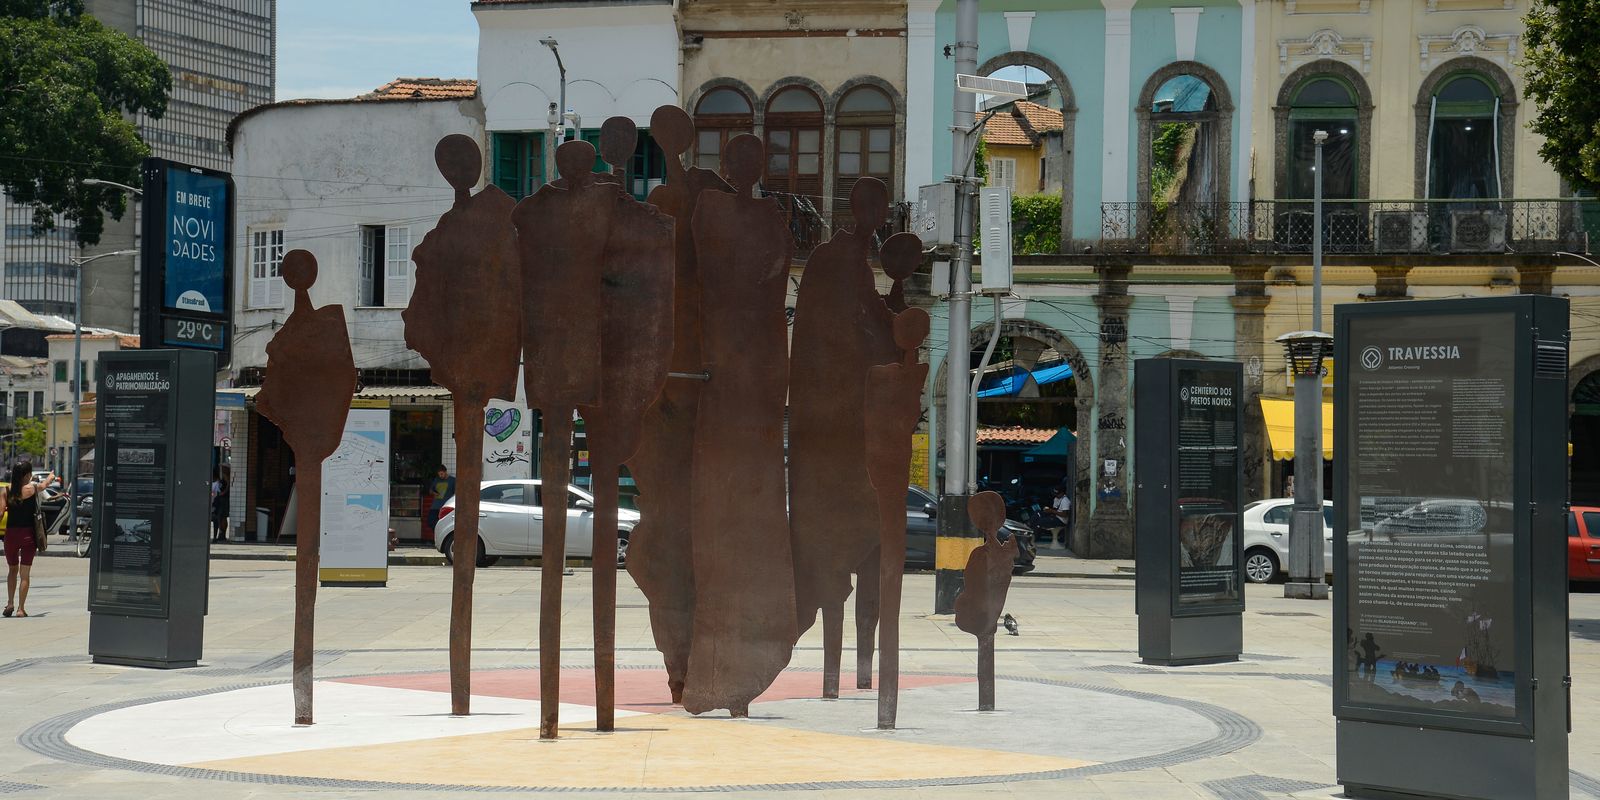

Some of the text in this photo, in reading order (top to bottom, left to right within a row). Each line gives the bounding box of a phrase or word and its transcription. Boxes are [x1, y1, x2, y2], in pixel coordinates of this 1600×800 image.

[176, 190, 211, 209] EM BREVE
[173, 214, 214, 242] NOVI
[172, 239, 216, 262] DADES
[1388, 345, 1461, 361] TRAVESSIA
[115, 372, 161, 382] APAGAMENTOS E
[115, 379, 171, 392] PATRIMONIALIZAÇÃO
[1190, 383, 1232, 396] CEMITÉRIO DOS
[1190, 396, 1232, 407] PRETOS NOVOS
